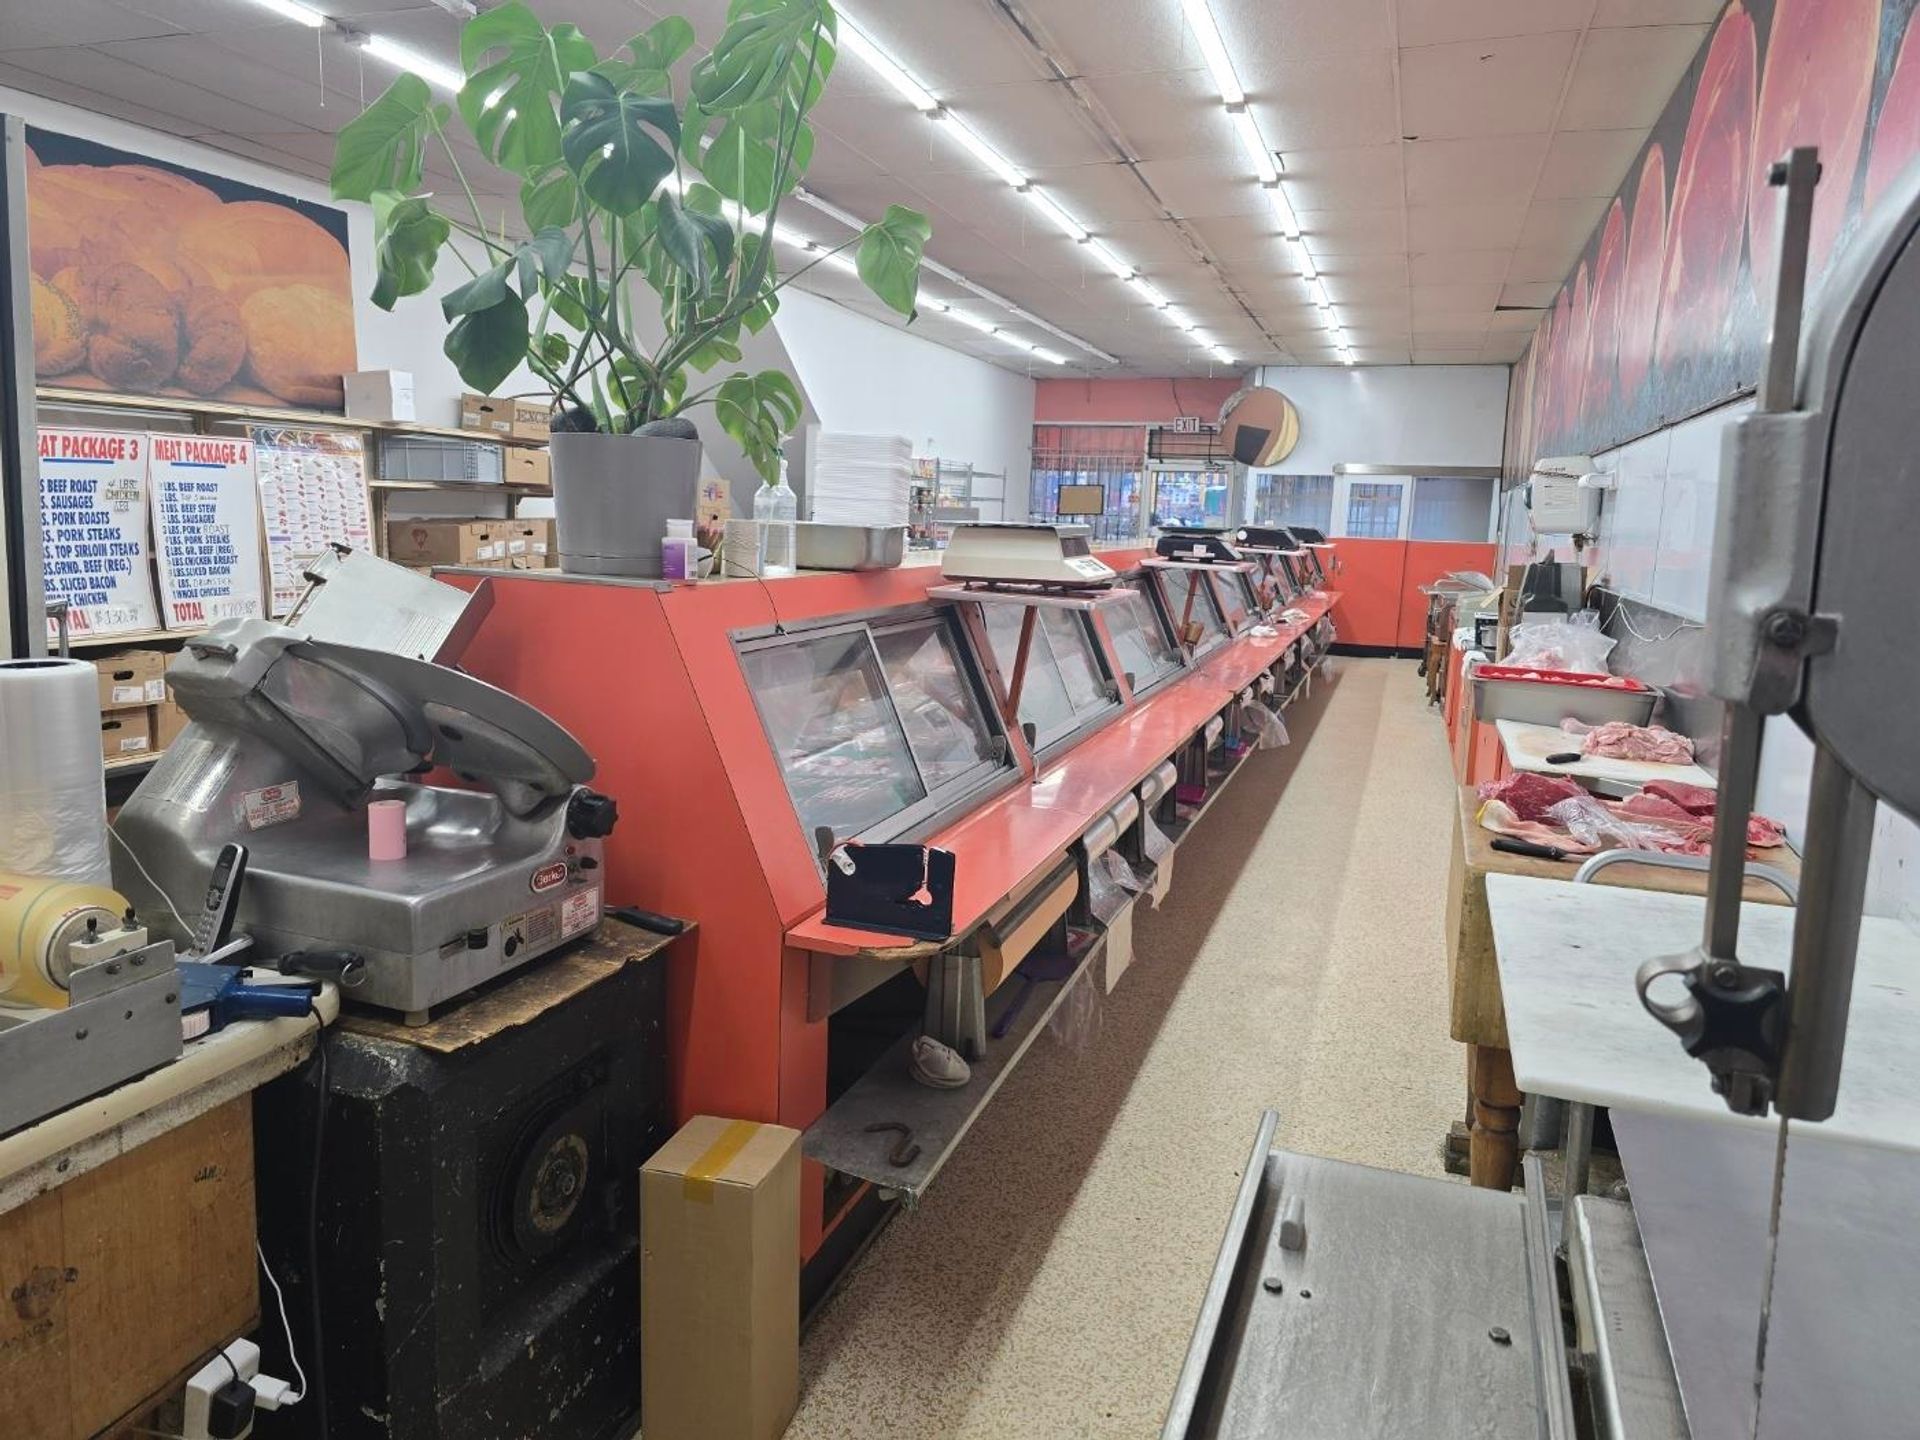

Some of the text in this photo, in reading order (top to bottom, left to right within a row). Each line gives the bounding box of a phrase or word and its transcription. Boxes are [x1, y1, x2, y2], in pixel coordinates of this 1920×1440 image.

[516, 408, 550, 424] EXCE
[1175, 418, 1197, 431] EXIT
[38, 435, 139, 460] AT PACKAGE 3
[154, 439, 182, 461] MEAT
[185, 442, 237, 464] PACKAGE
[239, 445, 248, 464] 4
[47, 479, 67, 493] BEEF
[70, 480, 98, 493] ROAST
[178, 483, 194, 492] BEEF
[196, 483, 218, 493] ROAST
[51, 495, 93, 509] SAUSAGES
[181, 504, 198, 513] BEEF
[198, 504, 216, 513] STEW
[41, 511, 110, 526] S. PORK ROASTS
[182, 514, 215, 524] SAUSAGES
[57, 529, 85, 542] PORK
[87, 527, 121, 541] STEAKS
[182, 525, 201, 534] PORK
[185, 535, 203, 545] PORK
[205, 534, 231, 544] STEAKS
[56, 545, 72, 558] TOP
[74, 544, 107, 558] SIRLOIN
[109, 542, 140, 556] STEAKS
[198, 545, 214, 555] BEEF
[84, 560, 102, 573] BEEF
[104, 557, 132, 575] (REG.)
[213, 555, 238, 565] BREAST
[208, 566, 230, 575] BACON
[45, 576, 117, 592] BS. SLICED BACON
[74, 592, 109, 607] CHICKEN
[173, 602, 204, 622] TOTAL
